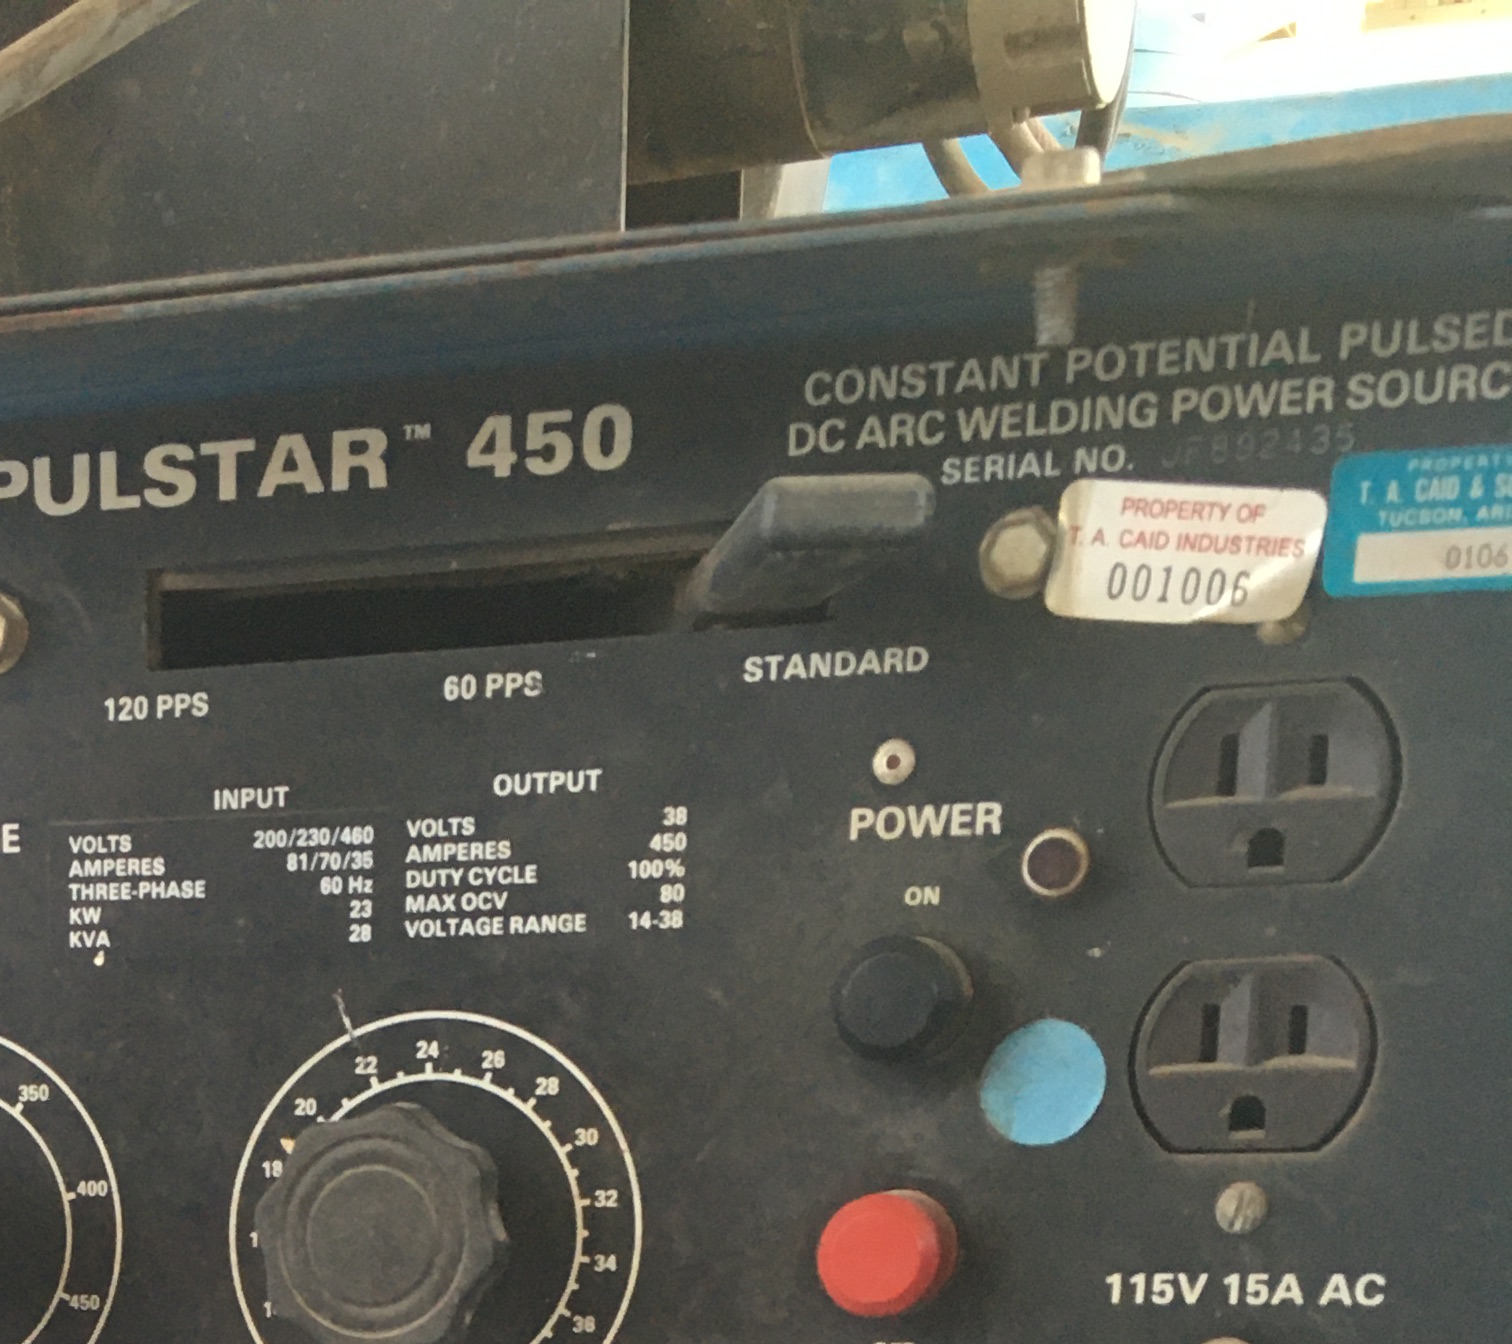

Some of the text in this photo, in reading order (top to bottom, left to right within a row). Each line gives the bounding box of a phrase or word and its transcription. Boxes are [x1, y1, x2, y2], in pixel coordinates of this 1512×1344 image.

[806, 357, 1045, 407] CONSTANT
[1065, 329, 1322, 385] POTENTIAL
[787, 418, 846, 457] DC
[855, 410, 945, 450] ARC
[956, 391, 1158, 443] WELDING
[1171, 376, 1336, 424] POWER
[466, 403, 634, 478] 450
[941, 452, 1061, 487] SERIAL
[1073, 445, 1134, 477] NO.
[1122, 497, 1266, 523] PROPERTY OF
[1119, 529, 1169, 550] CAID
[1176, 532, 1306, 558] INDUSTRIES
[1107, 562, 1249, 607] 001006
[742, 646, 929, 683] STANDARD
[443, 670, 543, 702] 60 PPS
[104, 691, 209, 722] 120 PPS
[493, 769, 602, 796] OUTPUT
[214, 786, 289, 810] INPUT
[407, 806, 687, 838] VOLTS 38
[849, 801, 1003, 841] POWER
[69, 834, 132, 853] VOLTS
[405, 832, 687, 863] AMPERES 450
[69, 850, 373, 877] AMPERES 81/70/35
[406, 859, 685, 888] DUTY CYCLE 100%
[69, 876, 373, 900] THREE-PHASE 60 Hz
[405, 884, 685, 913] MAX OCV 80
[904, 885, 941, 906] ON
[69, 899, 372, 924] KW 23
[404, 910, 683, 938] VOLTAGE RANGE 14-38
[69, 924, 371, 948] KVA 28
[416, 1041, 439, 1059] 24
[482, 1050, 505, 1069] 26
[355, 1057, 378, 1075] 22
[18, 1084, 50, 1102] 350
[535, 1078, 559, 1096] 28
[295, 1099, 317, 1116] 20
[575, 1129, 598, 1145] 30
[262, 1161, 282, 1177] 18
[76, 1181, 108, 1197] 400
[594, 1190, 618, 1207] 32
[594, 1255, 617, 1271] 34
[69, 1293, 101, 1311] 450
[1105, 1272, 1387, 1307] 115V 15A AC
